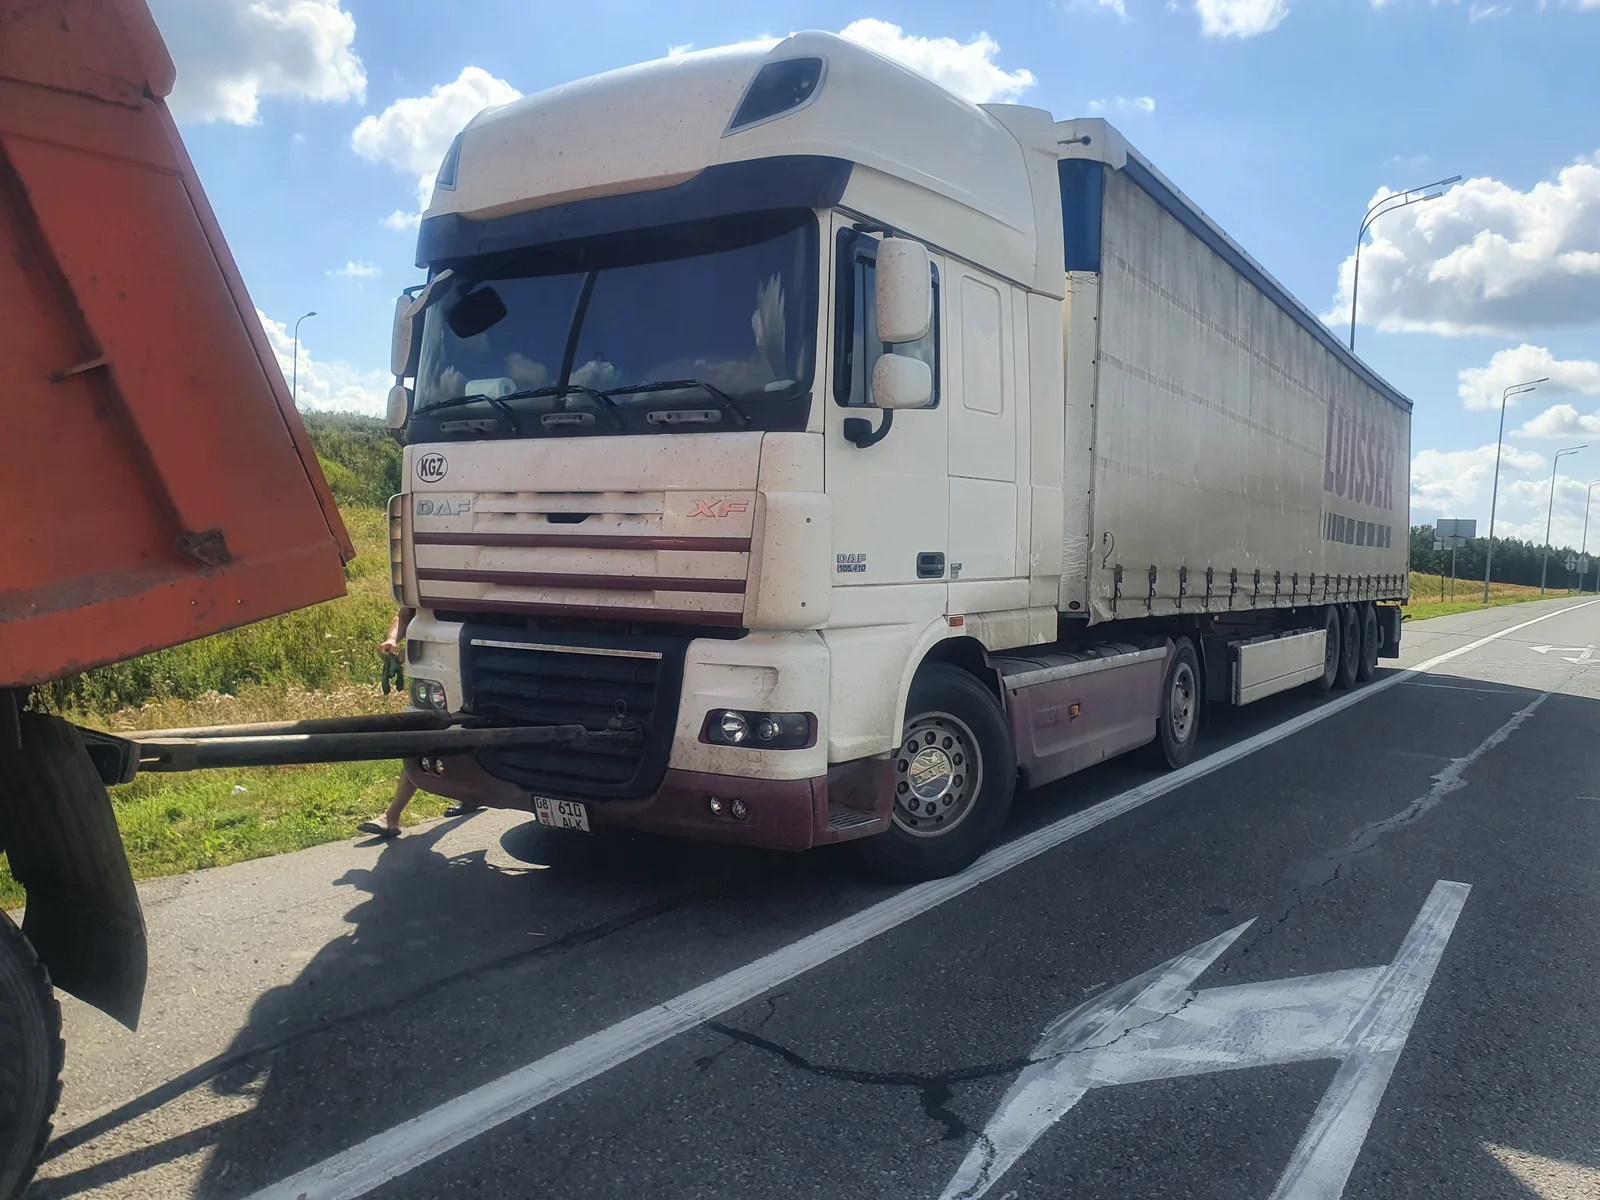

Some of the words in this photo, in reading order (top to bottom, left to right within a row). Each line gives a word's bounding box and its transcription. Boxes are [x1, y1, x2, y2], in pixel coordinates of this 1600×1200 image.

[420, 455, 445, 478] KGZ
[416, 499, 471, 516] DAF
[686, 499, 749, 518] XF
[836, 553, 867, 564] DAF
